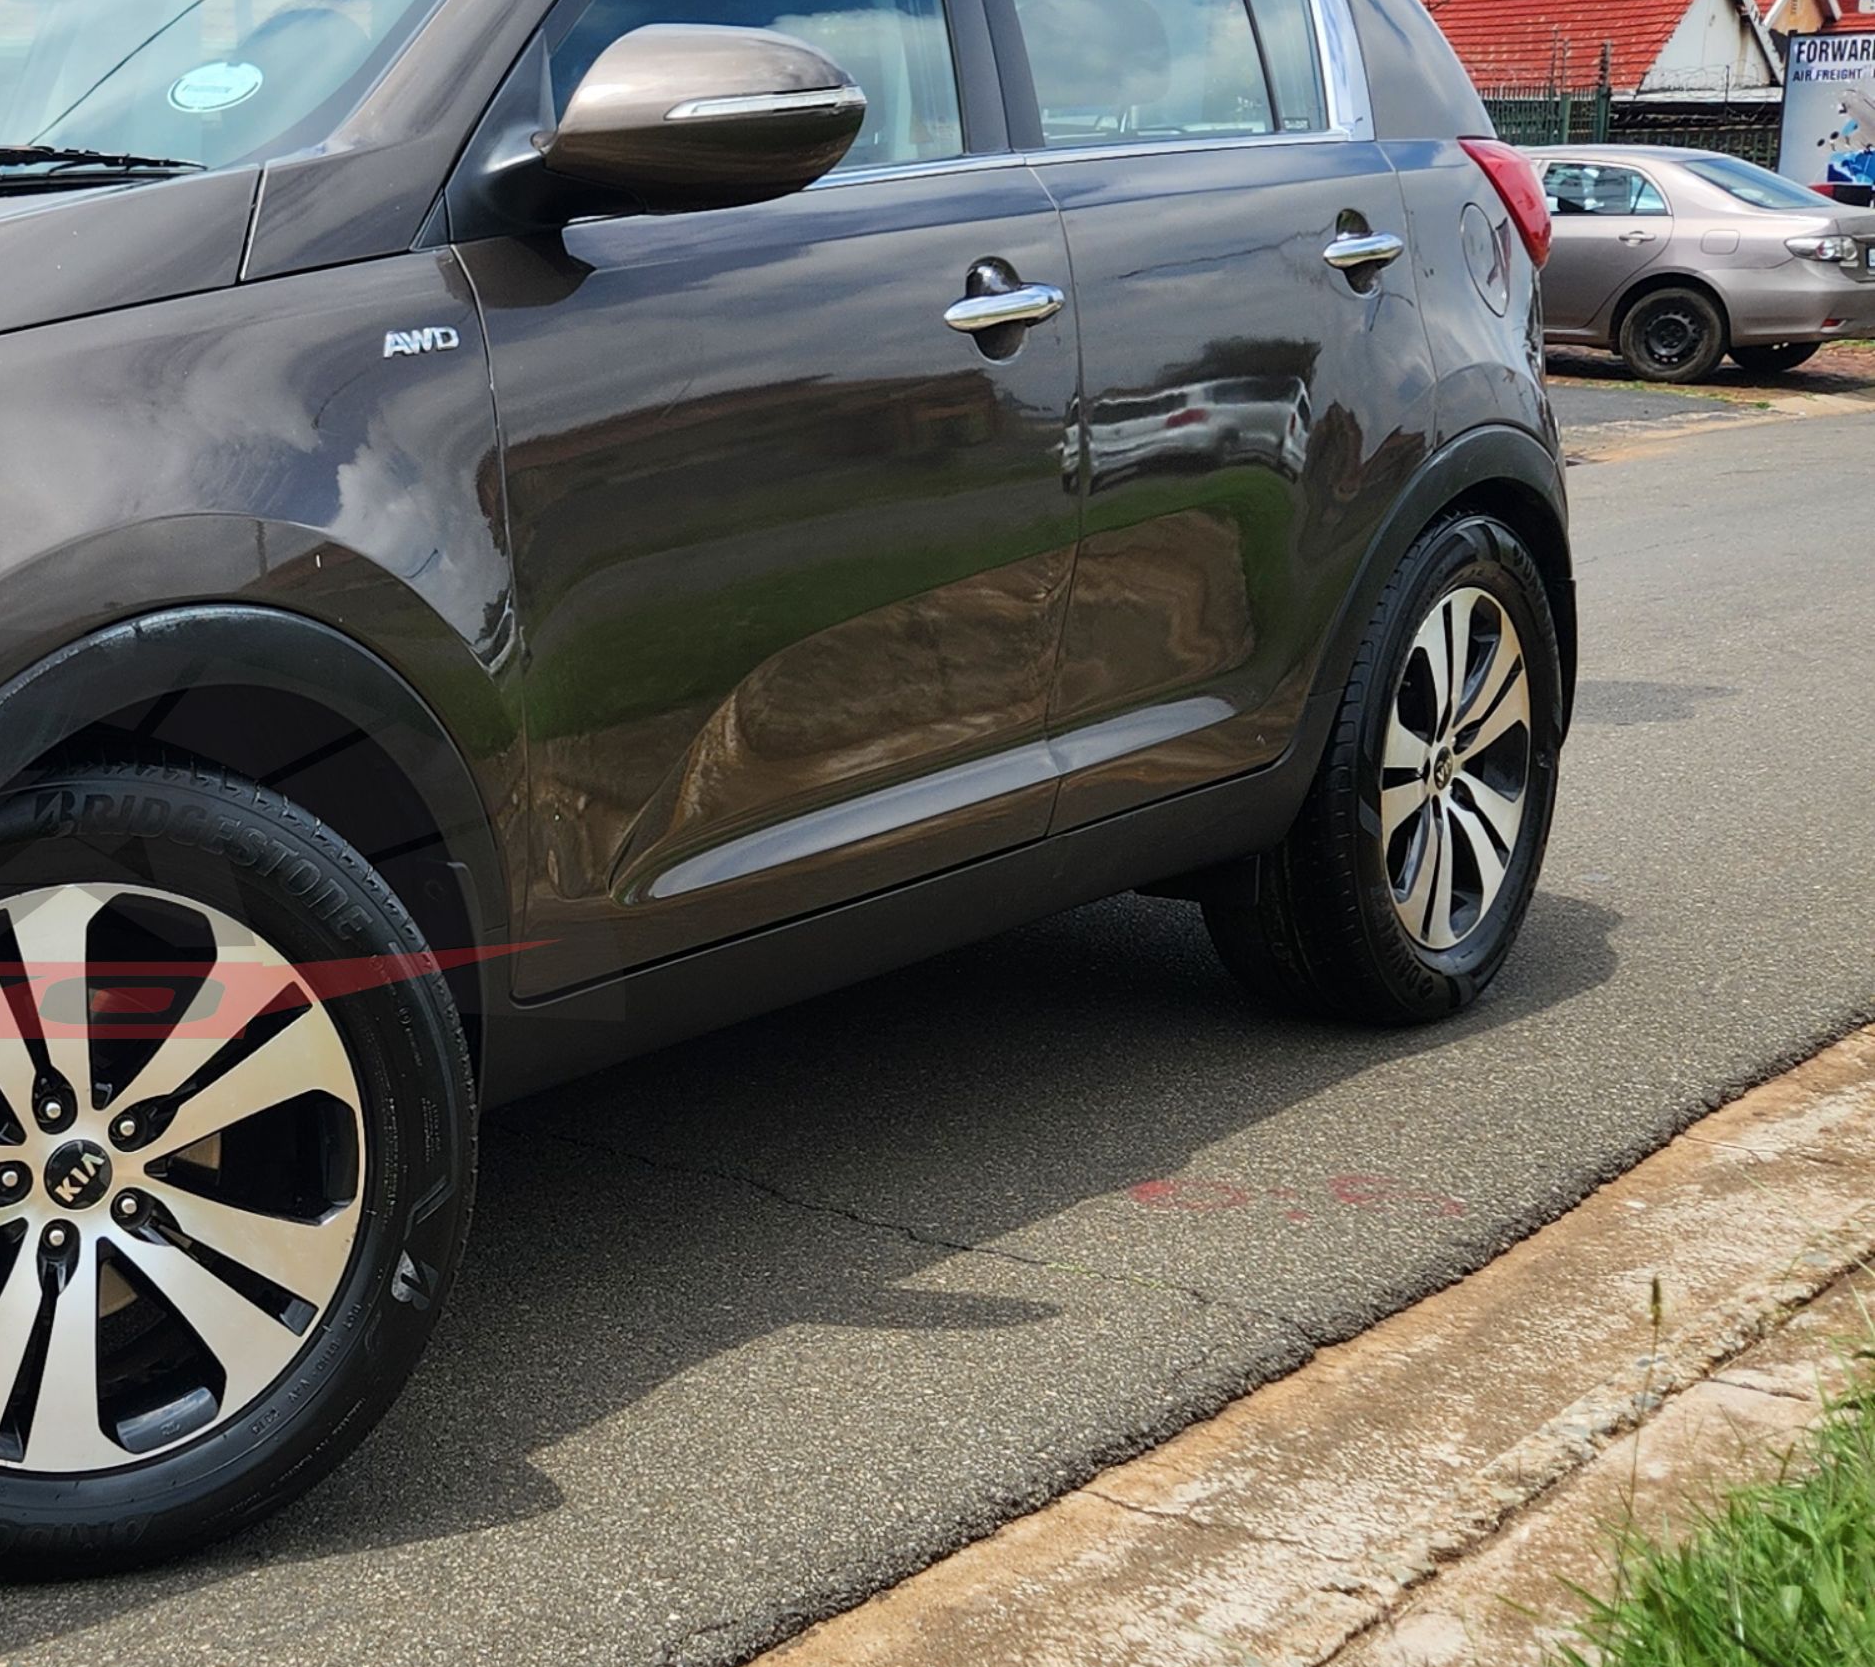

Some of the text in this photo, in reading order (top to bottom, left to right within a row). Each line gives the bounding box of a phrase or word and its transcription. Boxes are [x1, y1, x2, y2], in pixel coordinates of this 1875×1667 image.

[1796, 38, 1875, 64] FORWAR
[1792, 69, 1813, 82] AIR
[1815, 68, 1863, 81] FREIGHT
[382, 325, 460, 359] AWD
[34, 789, 374, 941] BRIDGESTONE
[54, 1152, 105, 1203] KIA
